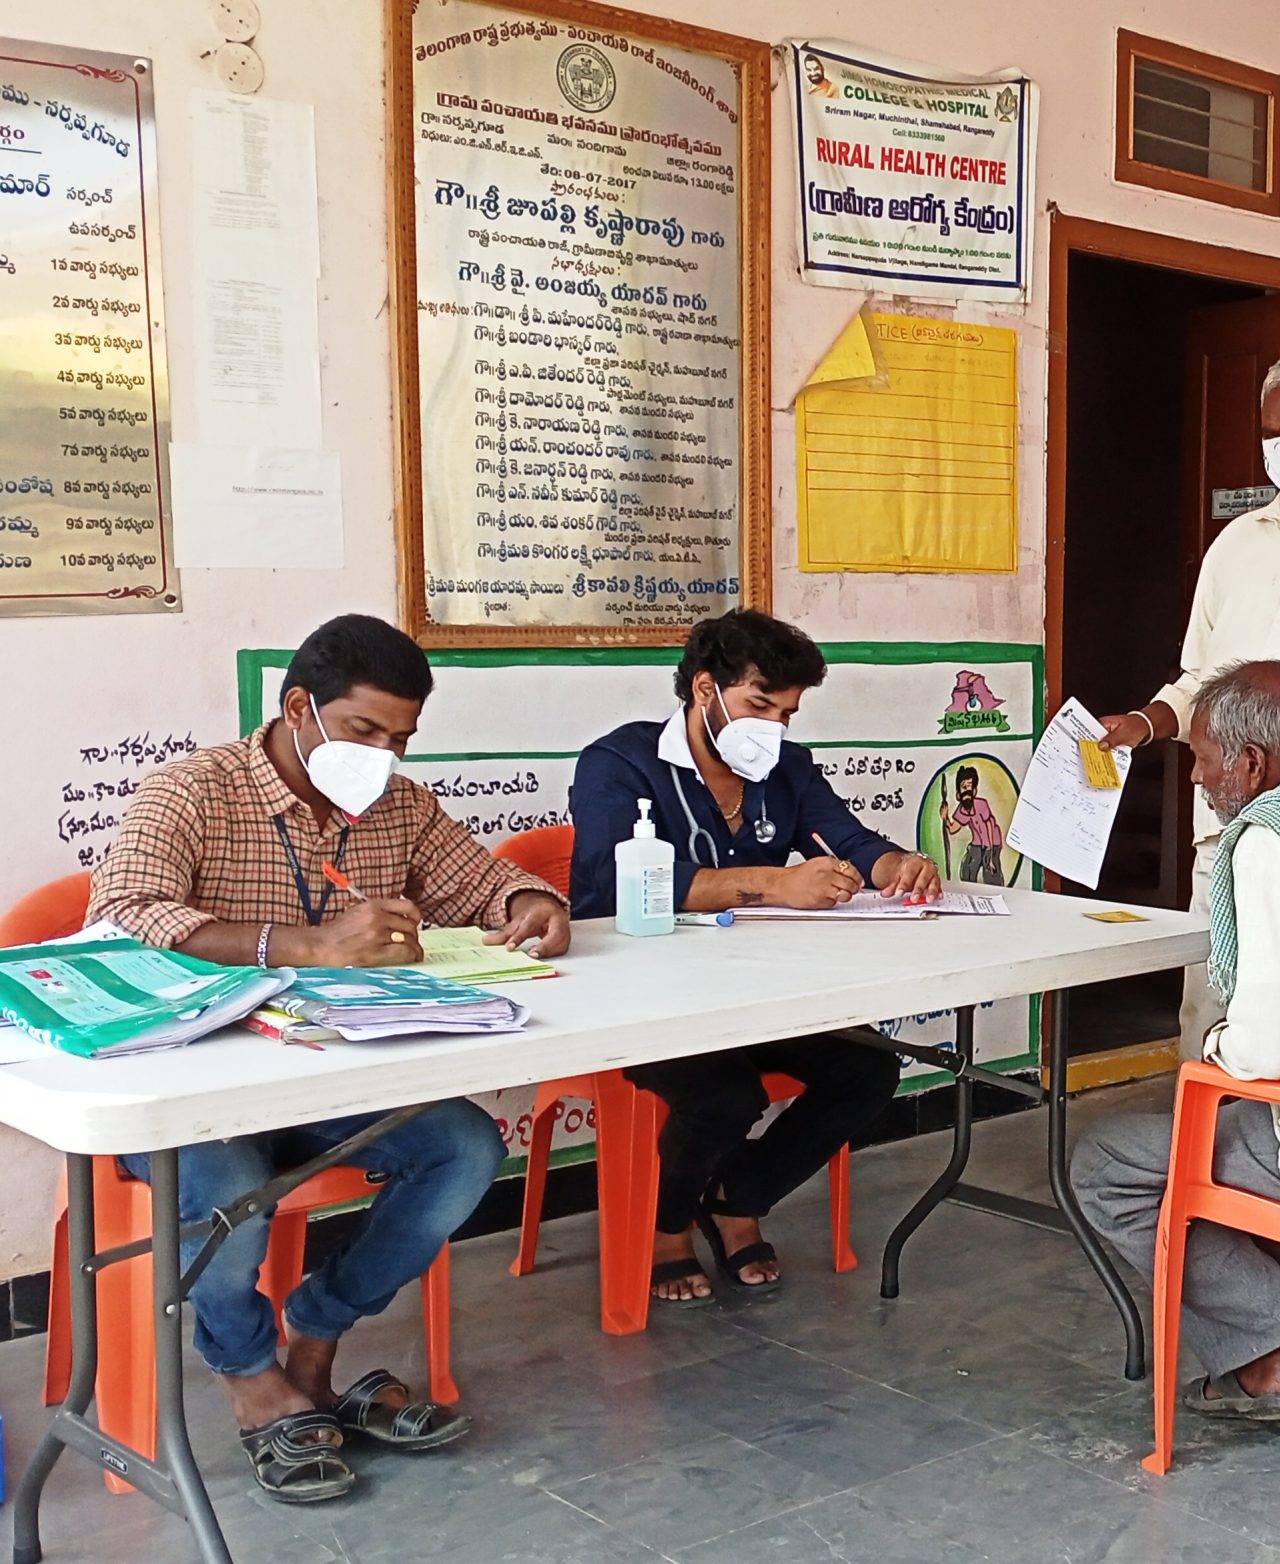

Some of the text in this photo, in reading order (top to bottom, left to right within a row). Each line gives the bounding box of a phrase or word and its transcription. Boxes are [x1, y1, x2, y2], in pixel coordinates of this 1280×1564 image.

[415, 33, 471, 61] తెలంగాణ
[843, 85, 988, 118] COLLEGE & HOSPITAL
[437, 92, 477, 110] గ్రామ
[561, 115, 617, 136] భవనము
[825, 106, 851, 118] Sriram
[853, 109, 877, 122] Nagar,
[878, 113, 920, 127] Muchinthal,
[45, 100, 130, 158] నర్సప్పగూడ
[816, 137, 1007, 185] RURAL HEALTH CENTRE
[564, 168, 636, 191] 08-07-2017
[66, 188, 113, 206] సర్పంచ్
[507, 197, 576, 236] జూపల్లి
[692, 229, 725, 249] గారు
[888, 193, 950, 237] ఆరోగ్య
[69, 222, 136, 243] ఉపసర్పంచ్
[70, 259, 97, 280] వార్డు
[100, 261, 139, 281] సభ్యులు
[535, 276, 608, 308] అంజయ్య
[611, 283, 668, 306] యాదవ్
[673, 293, 707, 312] గారు
[72, 297, 99, 317] వార్డు
[101, 299, 141, 318] సభ్యులు
[75, 335, 101, 353] వార్డు
[104, 336, 144, 354] సభ్యులు
[508, 332, 553, 348] బండారి
[77, 372, 103, 391] వార్డు
[106, 374, 146, 391] సభ్యులు
[509, 391, 564, 409] దామోదర్
[79, 409, 105, 427] వార్డు
[108, 410, 148, 427] సభ్యులు
[523, 417, 580, 434] నారాయణ
[81, 445, 107, 464] వార్డు
[110, 446, 150, 463] సభ్యులు
[83, 482, 110, 500] వార్డు
[113, 482, 152, 499] సభ్యులు
[561, 486, 599, 504] కుమార్
[85, 518, 112, 537] వార్డు
[115, 519, 155, 536] సభ్యులు
[532, 544, 568, 560] కొంగర
[88, 554, 114, 573] వార్డు
[117, 554, 157, 572] సభ్యులు
[687, 577, 739, 595] యాదవ్
[895, 758, 916, 773] RO
